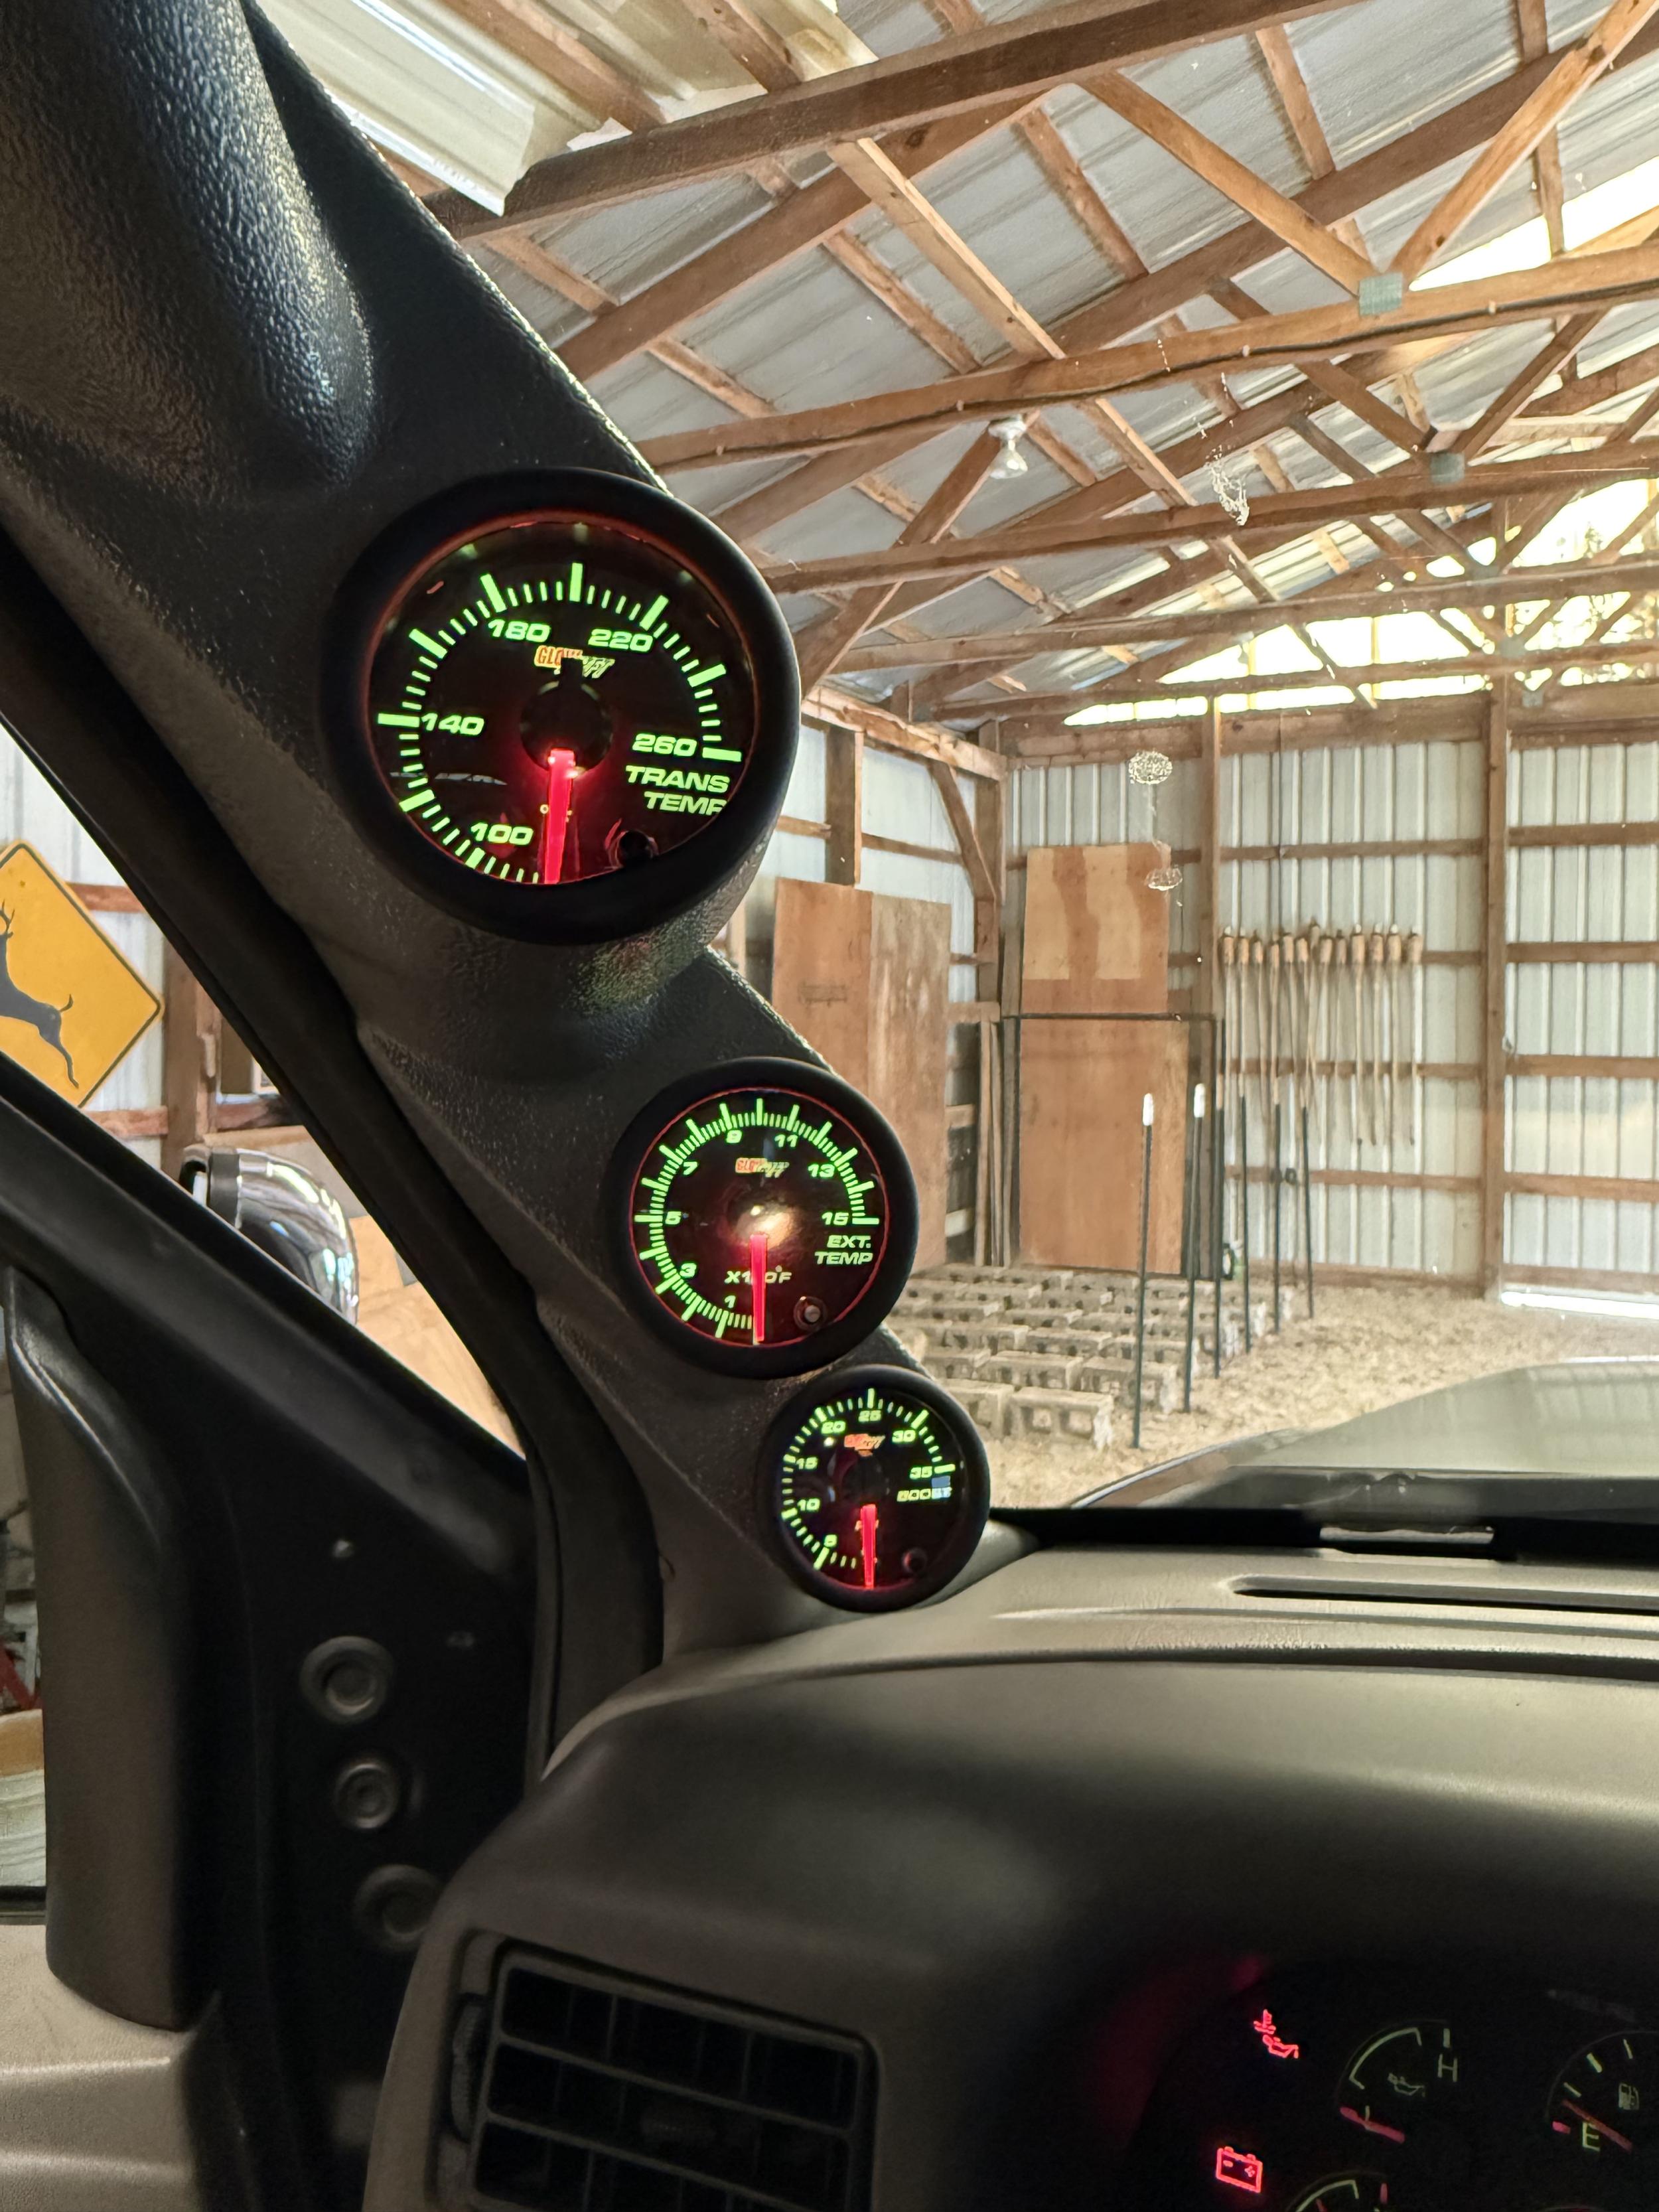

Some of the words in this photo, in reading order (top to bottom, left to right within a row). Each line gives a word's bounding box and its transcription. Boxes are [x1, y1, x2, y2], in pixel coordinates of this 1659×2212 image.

[488, 622, 551, 643] 180
[587, 628, 653, 652] 220
[421, 713, 484, 735] 140
[632, 733, 697, 757] 260
[625, 765, 730, 793] TRANS
[644, 791, 727, 816] TEMP
[470, 822, 534, 846] 100
[774, 1134, 798, 1147] 11
[683, 1161, 698, 1175] 7
[808, 1163, 835, 1177] 13
[664, 1211, 682, 1225] 5
[822, 1212, 849, 1226] 15
[827, 1234, 871, 1249] EXT.
[814, 1252, 873, 1265] TEMP
[680, 1263, 697, 1278] 3
[724, 1295, 736, 1308] 1
[892, 1430, 916, 1443] 30
[796, 1457, 818, 1469] 15
[909, 1465, 933, 1479] 35
[798, 1498, 820, 1511] 10
[1437, 2054, 1458, 2082] H
[1582, 2122, 1600, 2151] E
